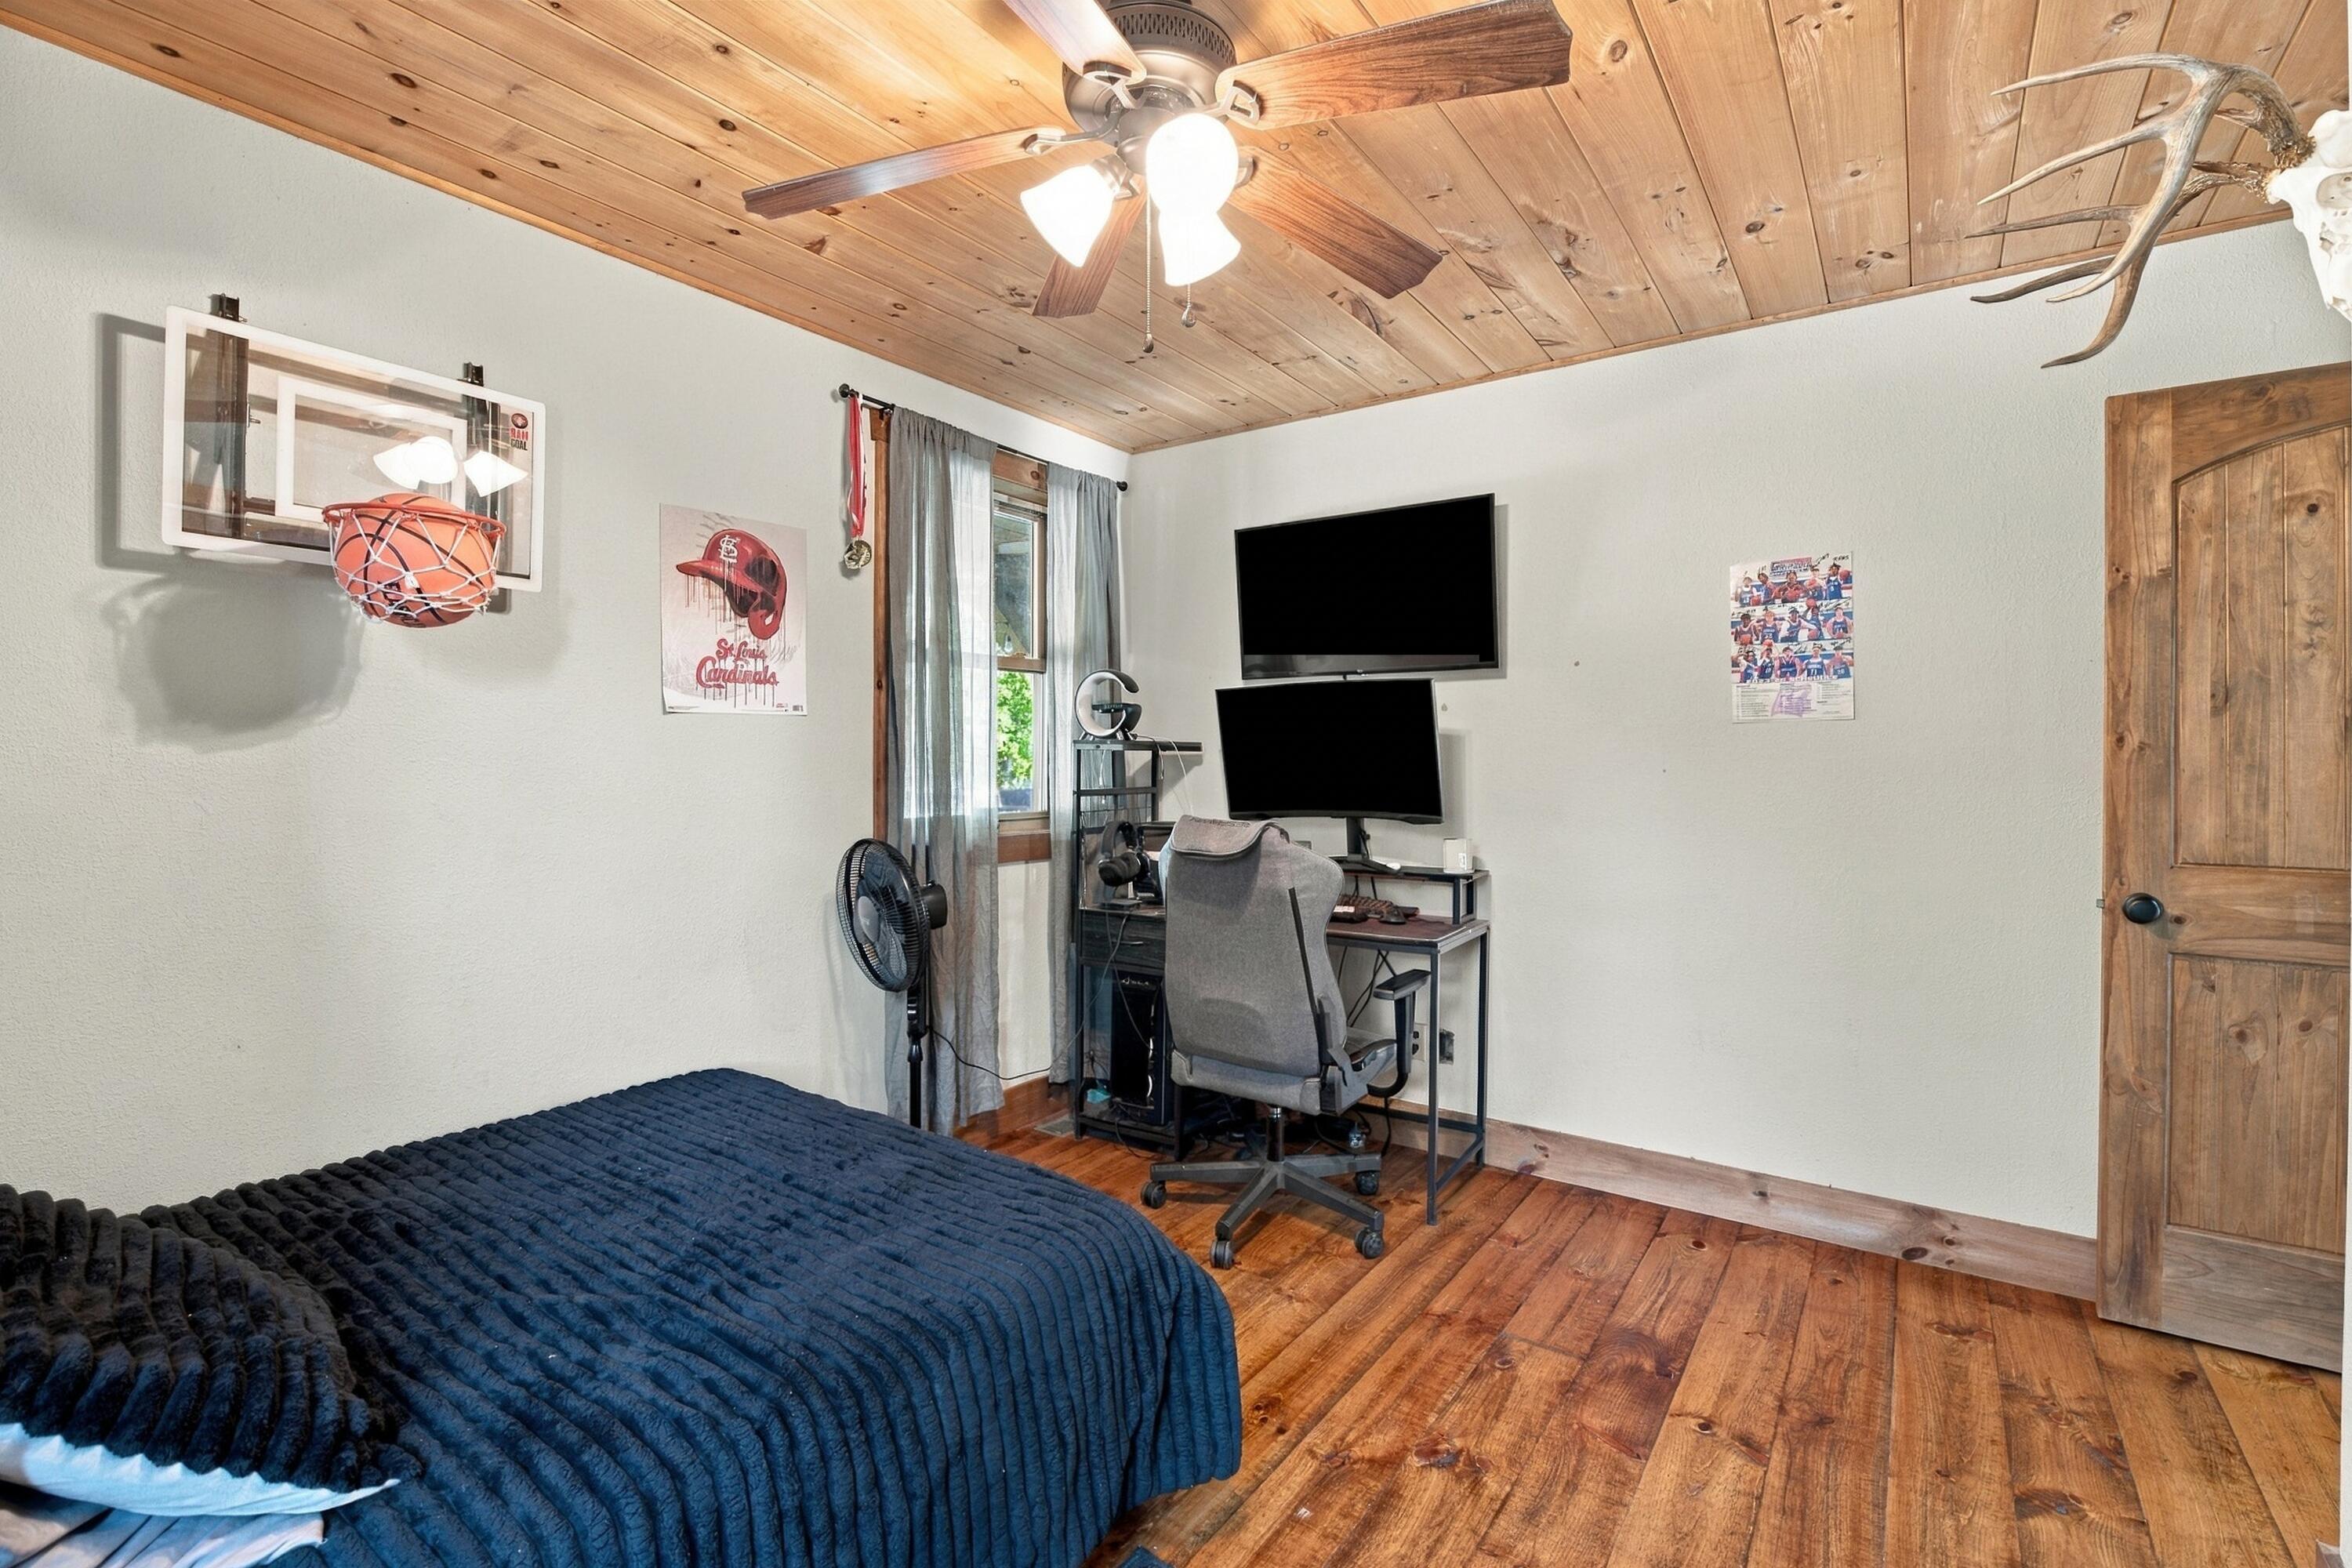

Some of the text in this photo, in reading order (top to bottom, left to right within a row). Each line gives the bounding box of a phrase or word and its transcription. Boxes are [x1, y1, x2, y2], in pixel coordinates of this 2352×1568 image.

[510, 439, 528, 451] GOAL
[734, 641, 768, 663] Louis
[696, 656, 779, 688] Cardinals
